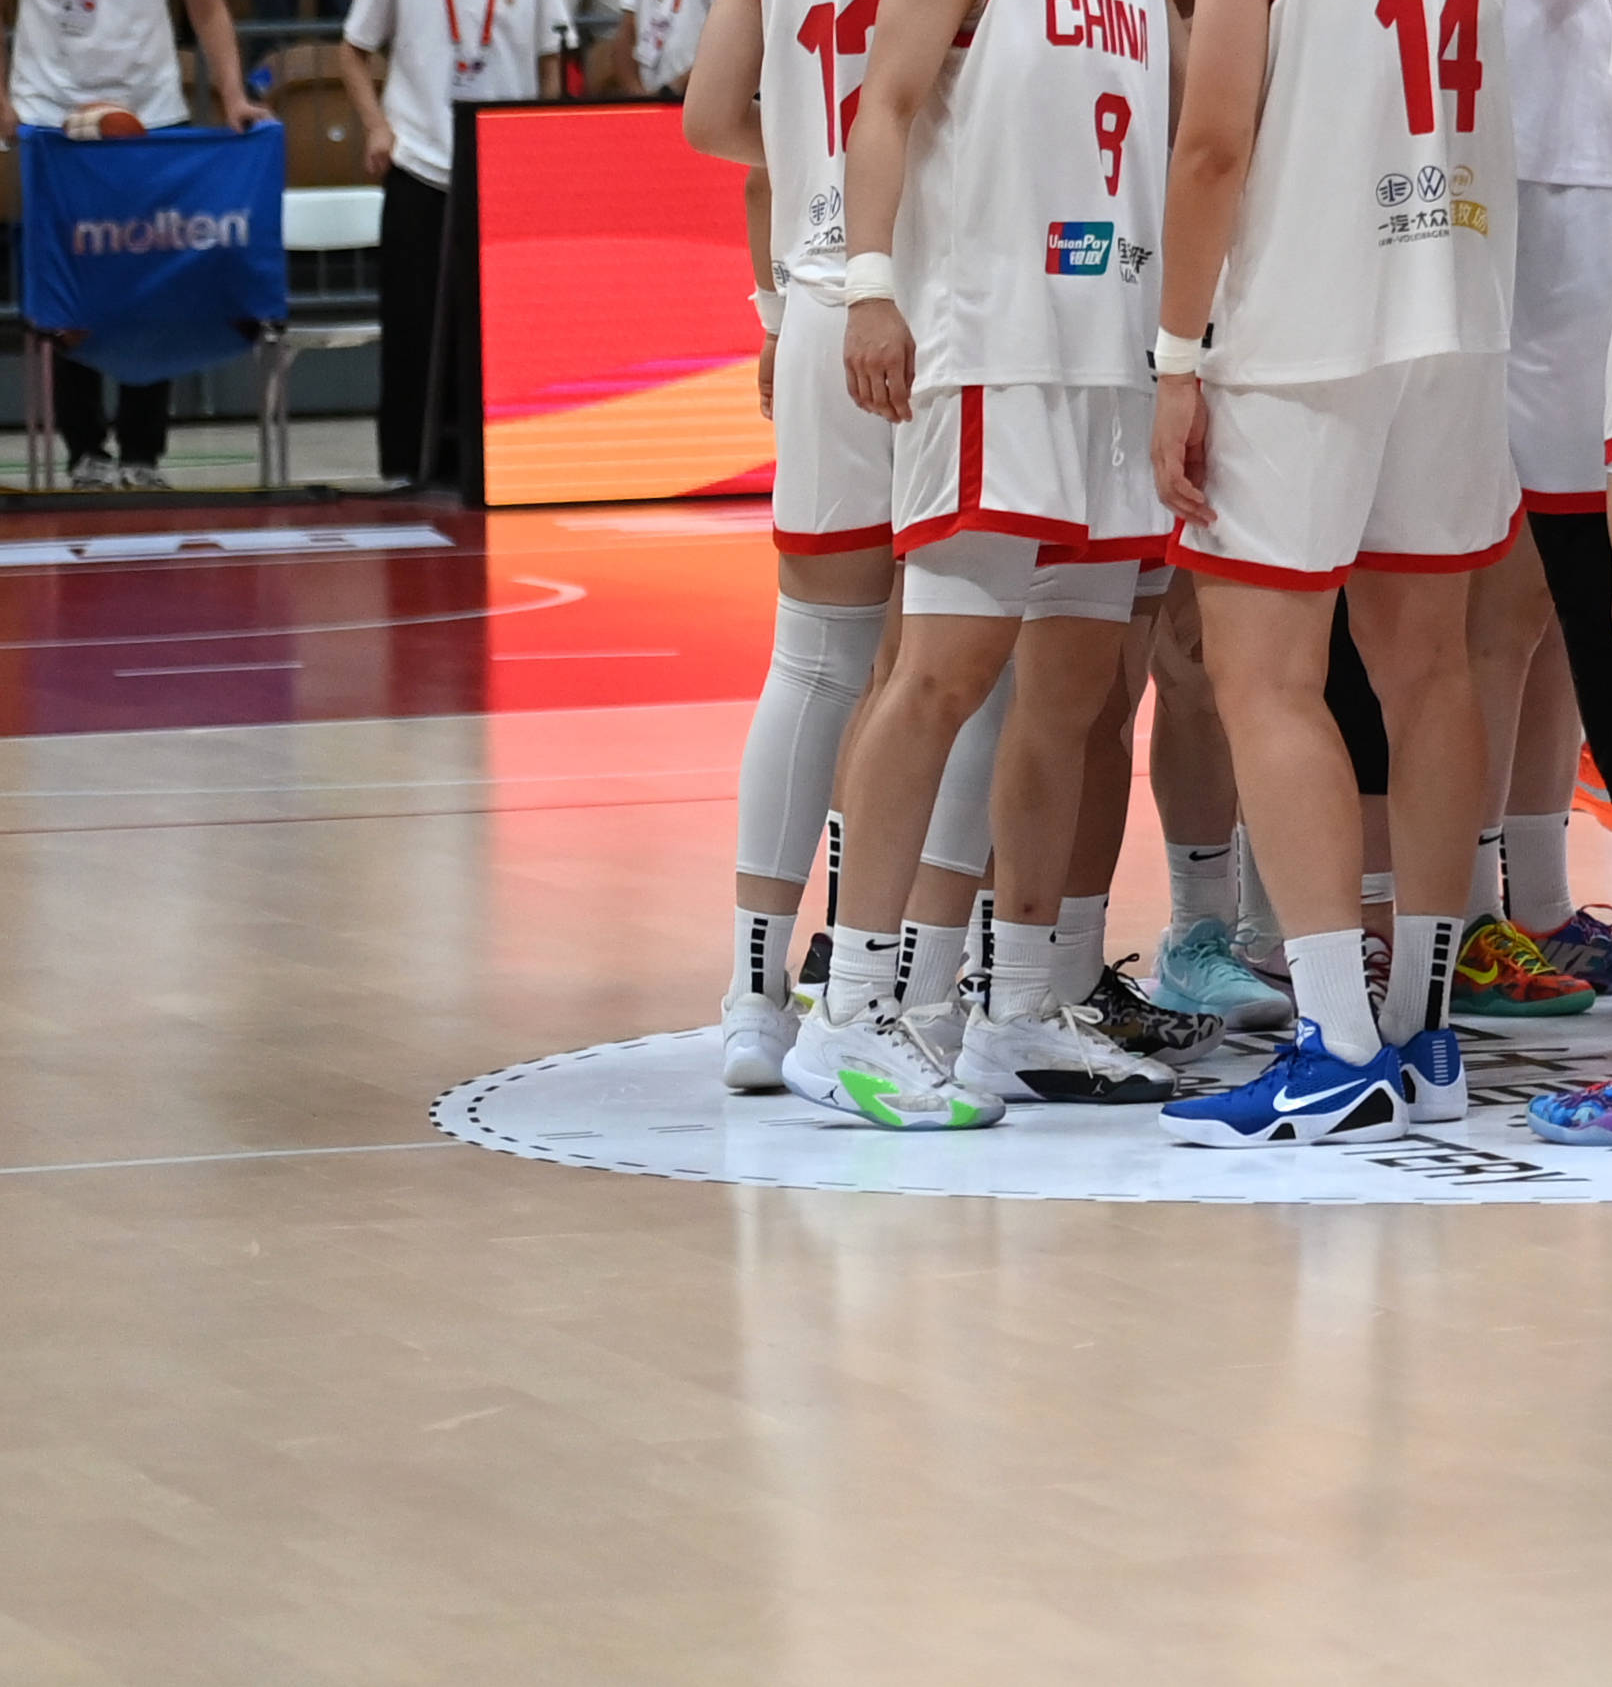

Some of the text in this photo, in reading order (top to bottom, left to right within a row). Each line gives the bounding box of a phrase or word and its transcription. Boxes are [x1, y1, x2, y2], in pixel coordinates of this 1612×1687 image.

[73, 208, 251, 255] molten
[1049, 233, 1110, 258] UnionPay
[1342, 1133, 1591, 1186] TERY
